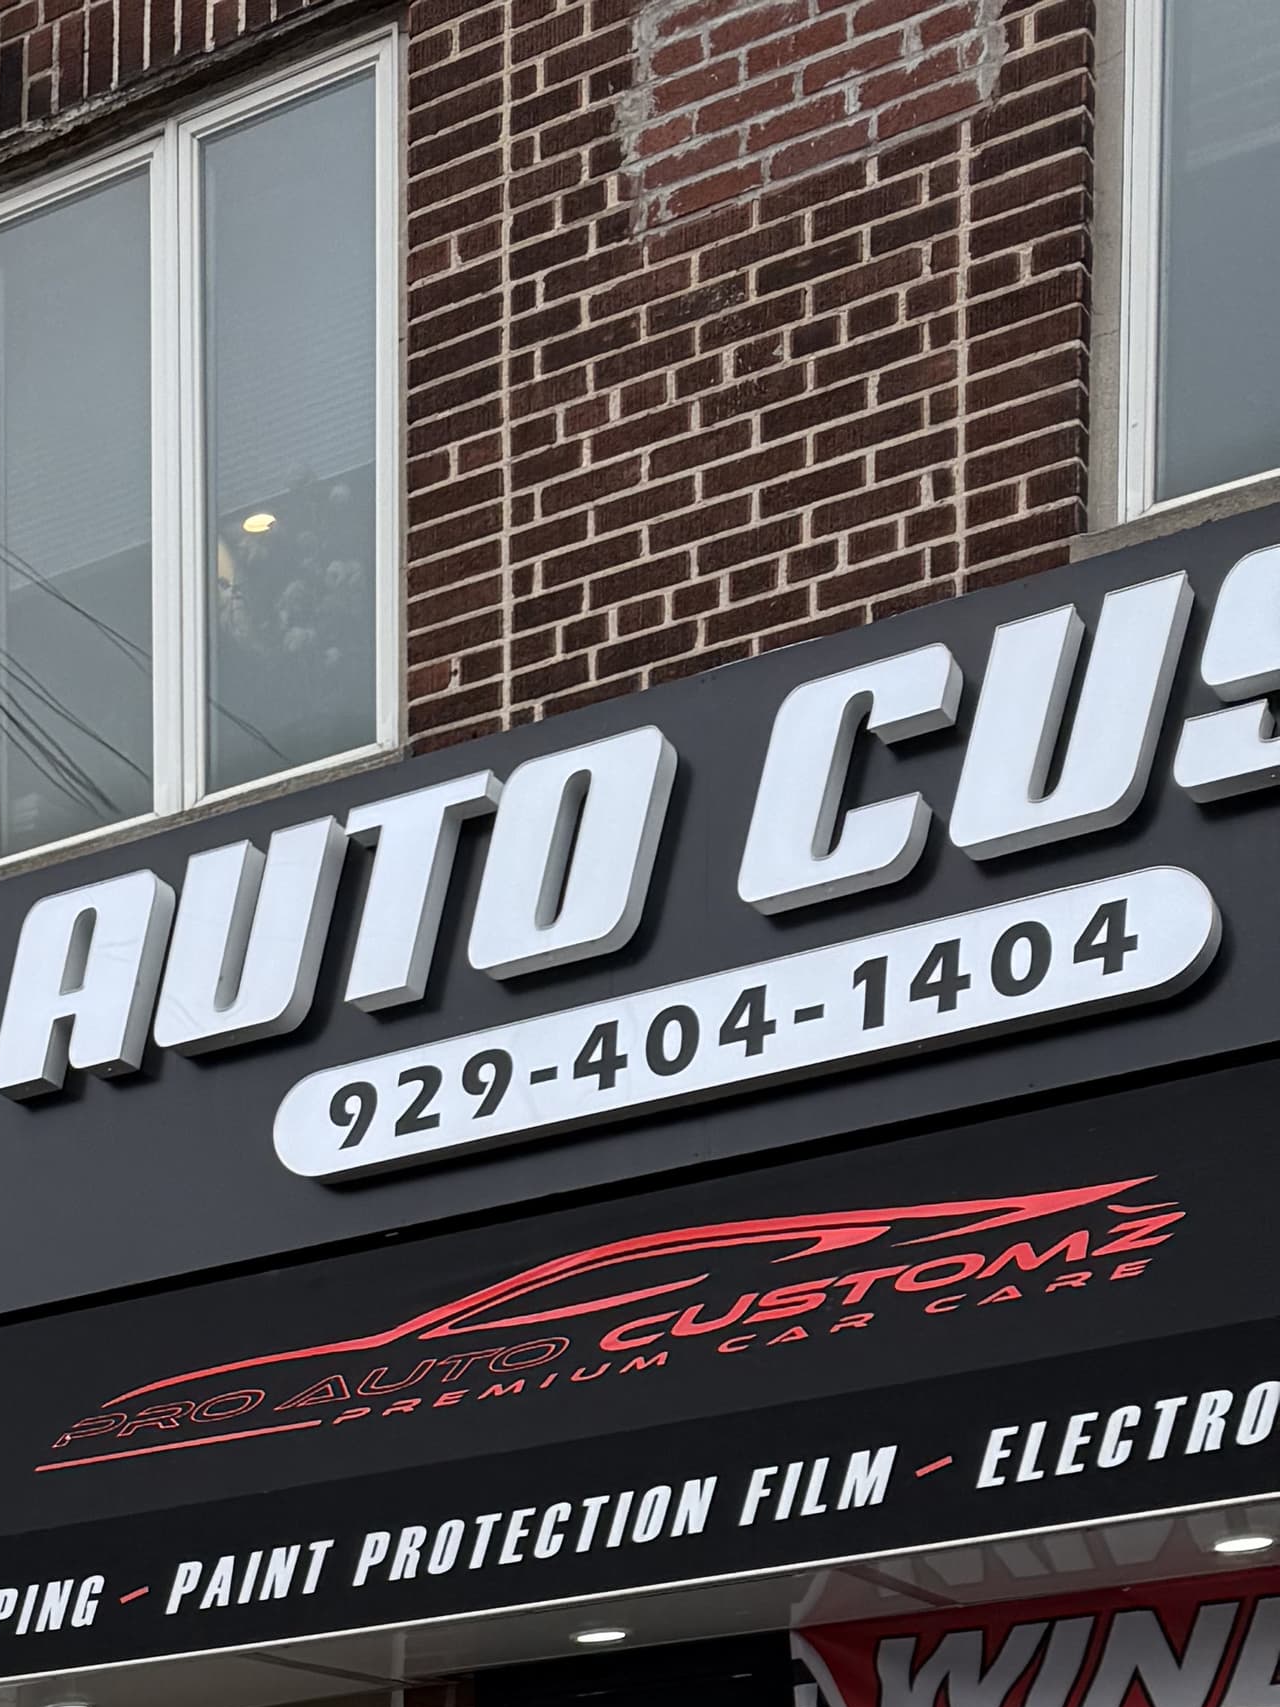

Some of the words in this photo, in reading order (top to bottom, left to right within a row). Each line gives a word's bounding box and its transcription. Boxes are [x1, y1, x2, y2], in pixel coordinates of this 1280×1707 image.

[328, 900, 1140, 1148] 929-404-1404
[53, 1390, 266, 1448] PRO
[275, 1338, 570, 1411] AUTO
[333, 1352, 667, 1424] PREMIUM
[717, 1312, 874, 1354] CAR
[924, 1258, 1152, 1314] CARE
[165, 1538, 330, 1616] PAINT
[354, 1475, 716, 1587] PROTECTION
[738, 1445, 898, 1530] FILM
